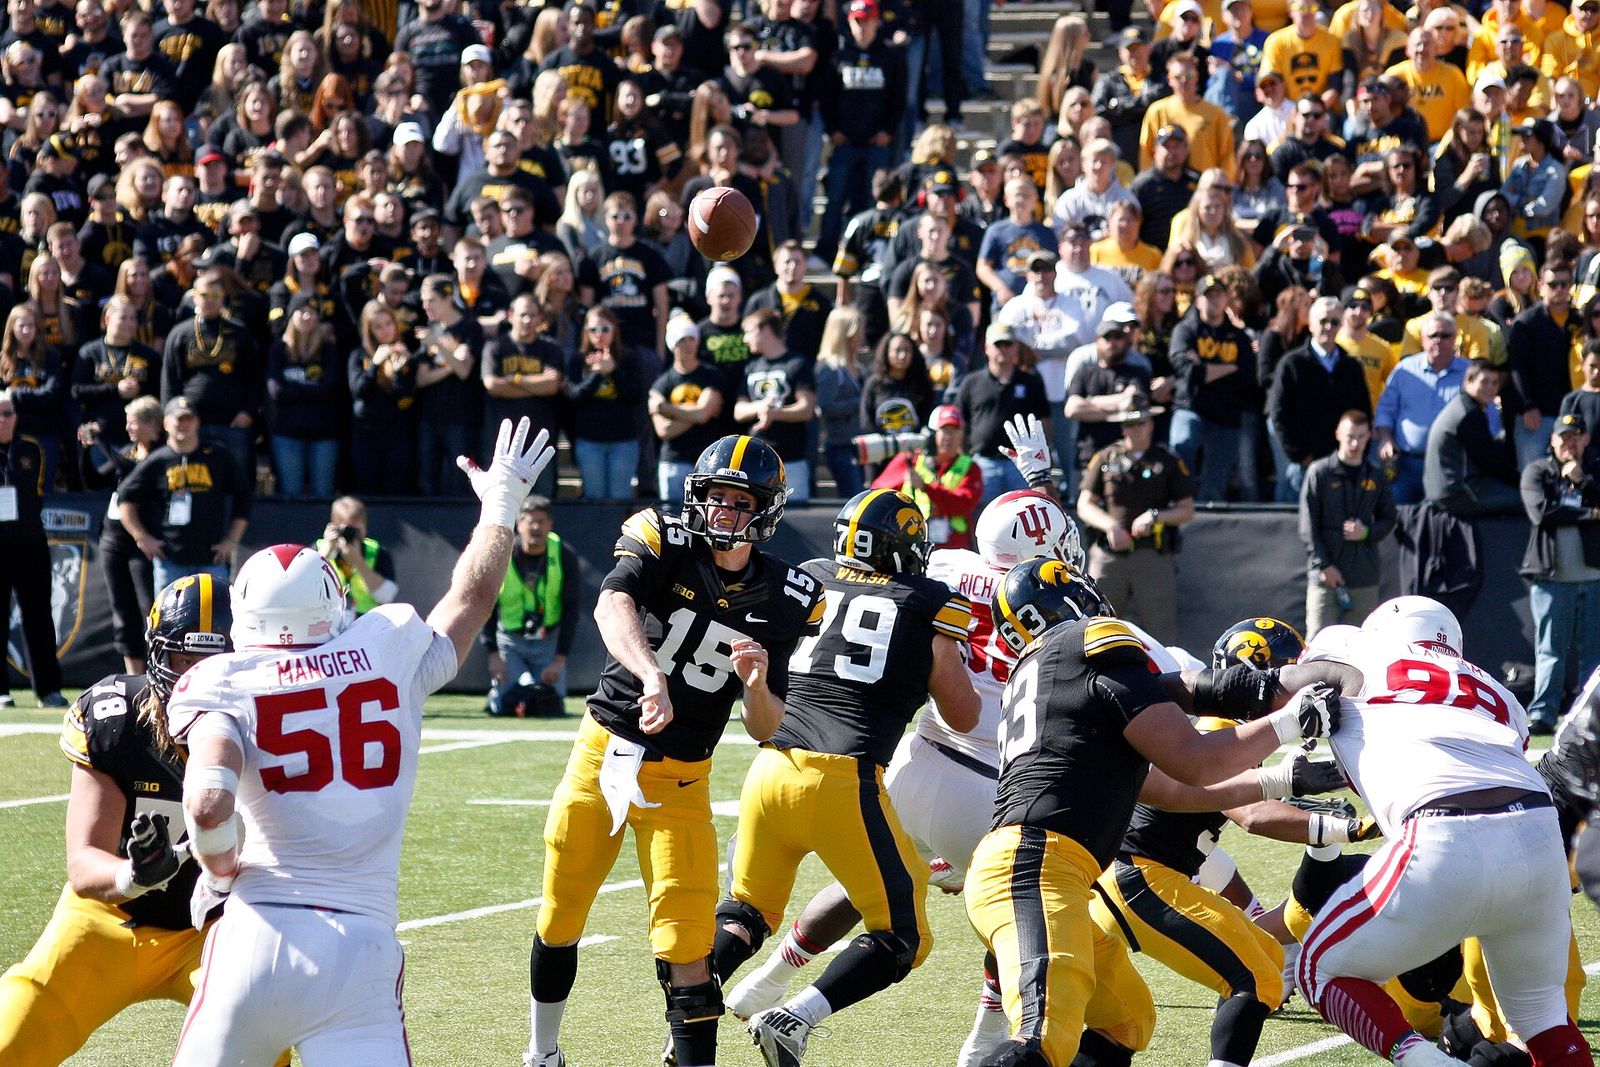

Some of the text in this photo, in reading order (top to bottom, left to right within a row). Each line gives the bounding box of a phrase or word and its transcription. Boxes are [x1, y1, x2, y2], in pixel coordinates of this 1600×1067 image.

[609, 139, 648, 175] 93
[724, 469, 741, 477] IOWA
[662, 515, 693, 549] 15
[836, 523, 873, 558] 79
[783, 567, 815, 609] 15
[835, 566, 893, 586] WELSH
[958, 573, 997, 600] RICH
[279, 633, 294, 645] 56
[787, 589, 899, 685] 79
[1000, 604, 1047, 650] 63
[1436, 632, 1447, 643] 98
[276, 648, 372, 686] MANGIERI
[650, 607, 754, 694] 15
[92, 680, 128, 721] 78
[1366, 658, 1511, 726] 98
[254, 676, 401, 795] 56
[1508, 802, 1525, 813] 98
[760, 1009, 803, 1038] NIKE
